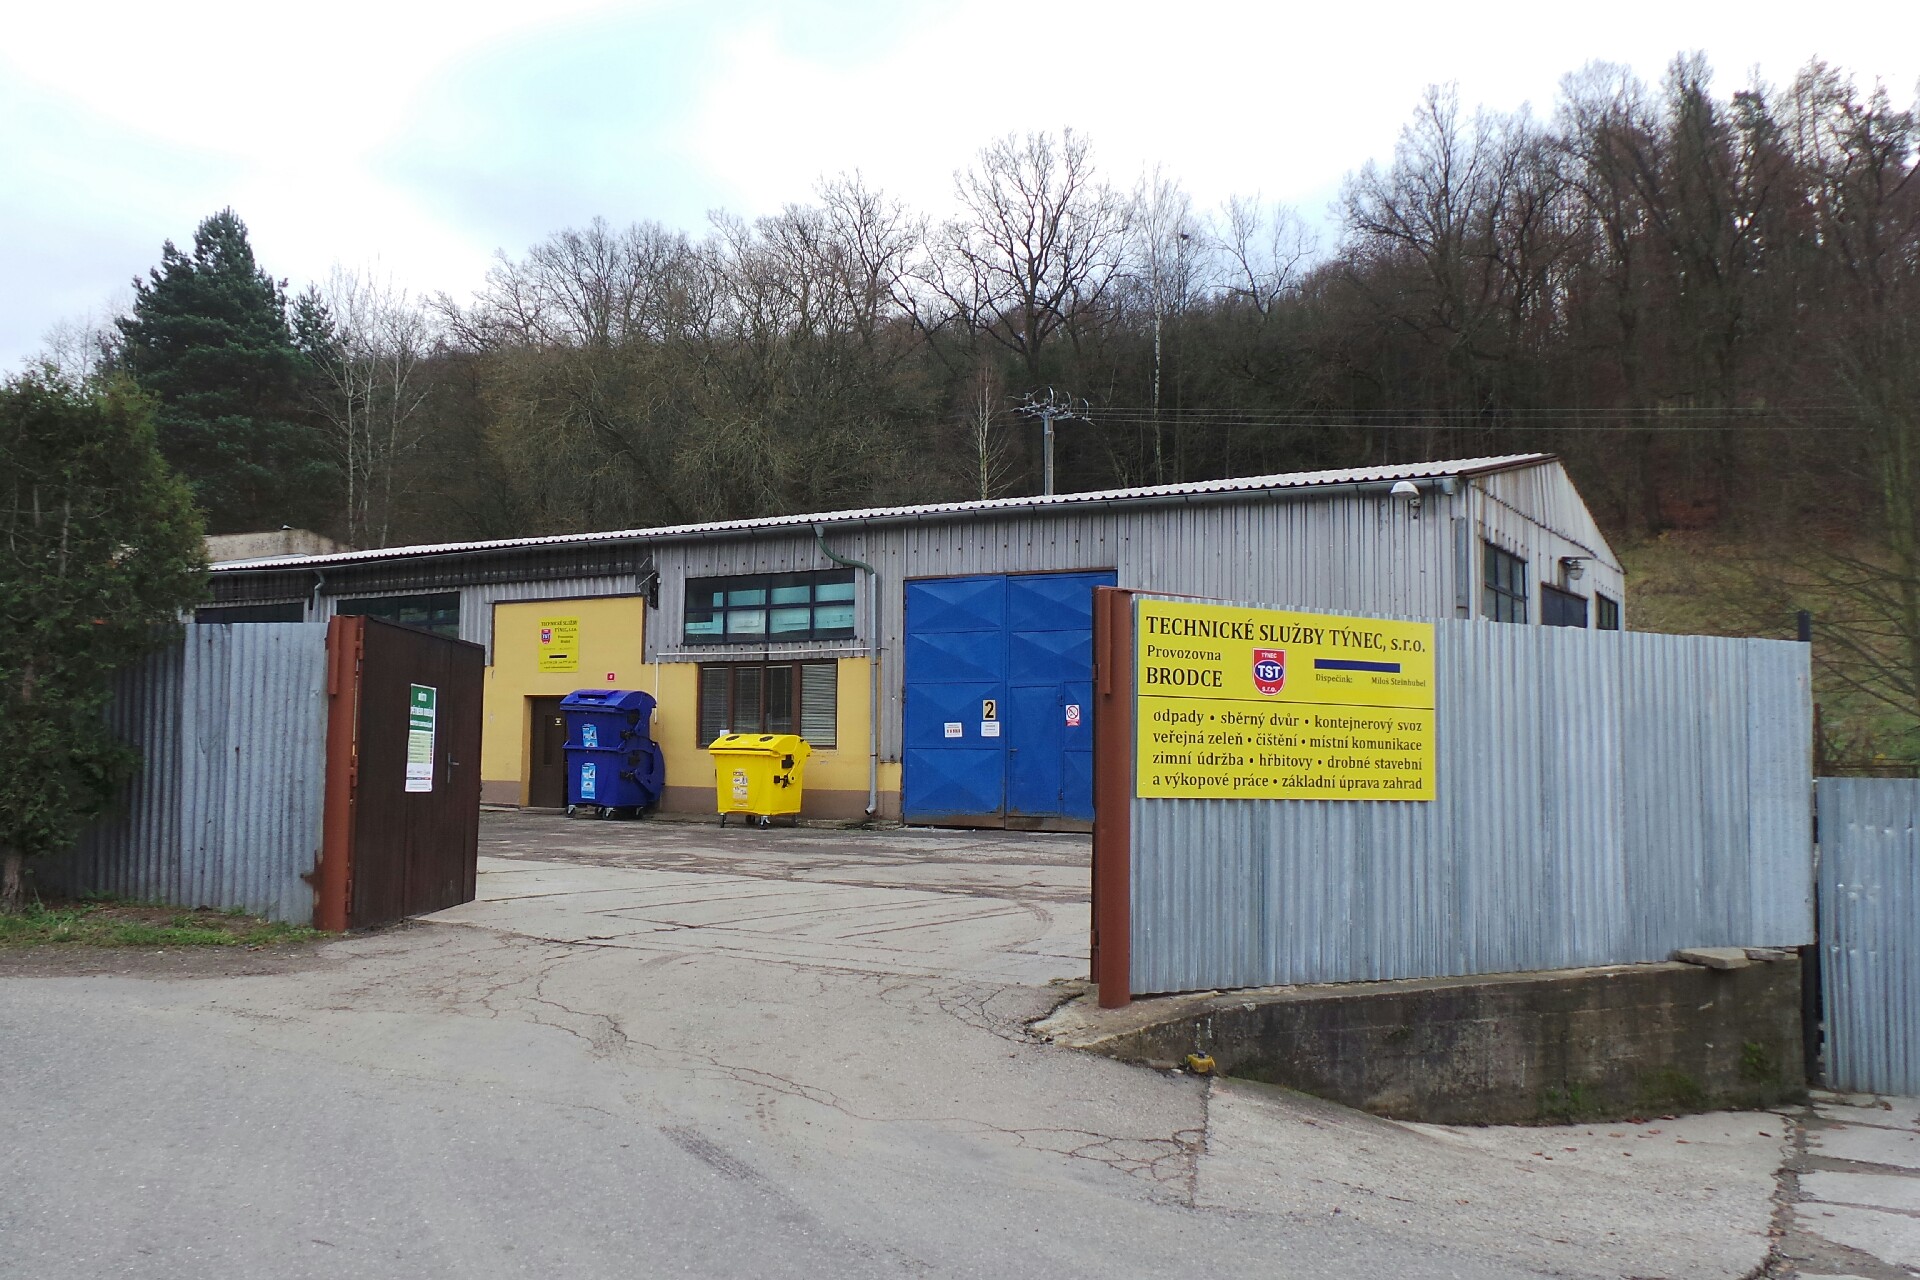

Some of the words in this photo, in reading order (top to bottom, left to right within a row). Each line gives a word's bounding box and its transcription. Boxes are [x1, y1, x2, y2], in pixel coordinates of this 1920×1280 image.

[1146, 616, 1254, 641] TECHNICKÉ
[1259, 622, 1324, 645] SLUŽBY
[1329, 626, 1386, 652] TÝNEC,
[1391, 638, 1425, 652] s.r.o.
[1147, 644, 1221, 661] Provozovna
[1146, 667, 1222, 687] BRODCE
[1257, 665, 1281, 679] TST
[1315, 673, 1353, 684] Dispečink:
[1371, 676, 1390, 685] Miloš
[985, 701, 994, 718] 2
[1153, 709, 1204, 726] odpady
[1221, 711, 1265, 728] sběrný
[1270, 712, 1299, 726] dvůr
[1315, 715, 1393, 733] kontejnerový
[1397, 721, 1422, 731] svoz
[1152, 730, 1204, 747] veřejná
[1208, 731, 1243, 745] zeleň
[1256, 733, 1298, 747] čištění
[1309, 735, 1349, 749] místní
[1352, 736, 1422, 751] komunikace
[1152, 751, 1192, 765] zimní
[1197, 751, 1244, 766] údržba
[1259, 753, 1313, 770] hřbitovy
[1327, 755, 1370, 769] drobné
[1374, 757, 1423, 771] stavební
[1152, 775, 1160, 786] a
[1165, 772, 1229, 789] výkopové
[1233, 773, 1269, 790] práce
[1282, 775, 1335, 788] základní
[1339, 775, 1380, 791] úprava
[1383, 776, 1423, 790] zahrad
